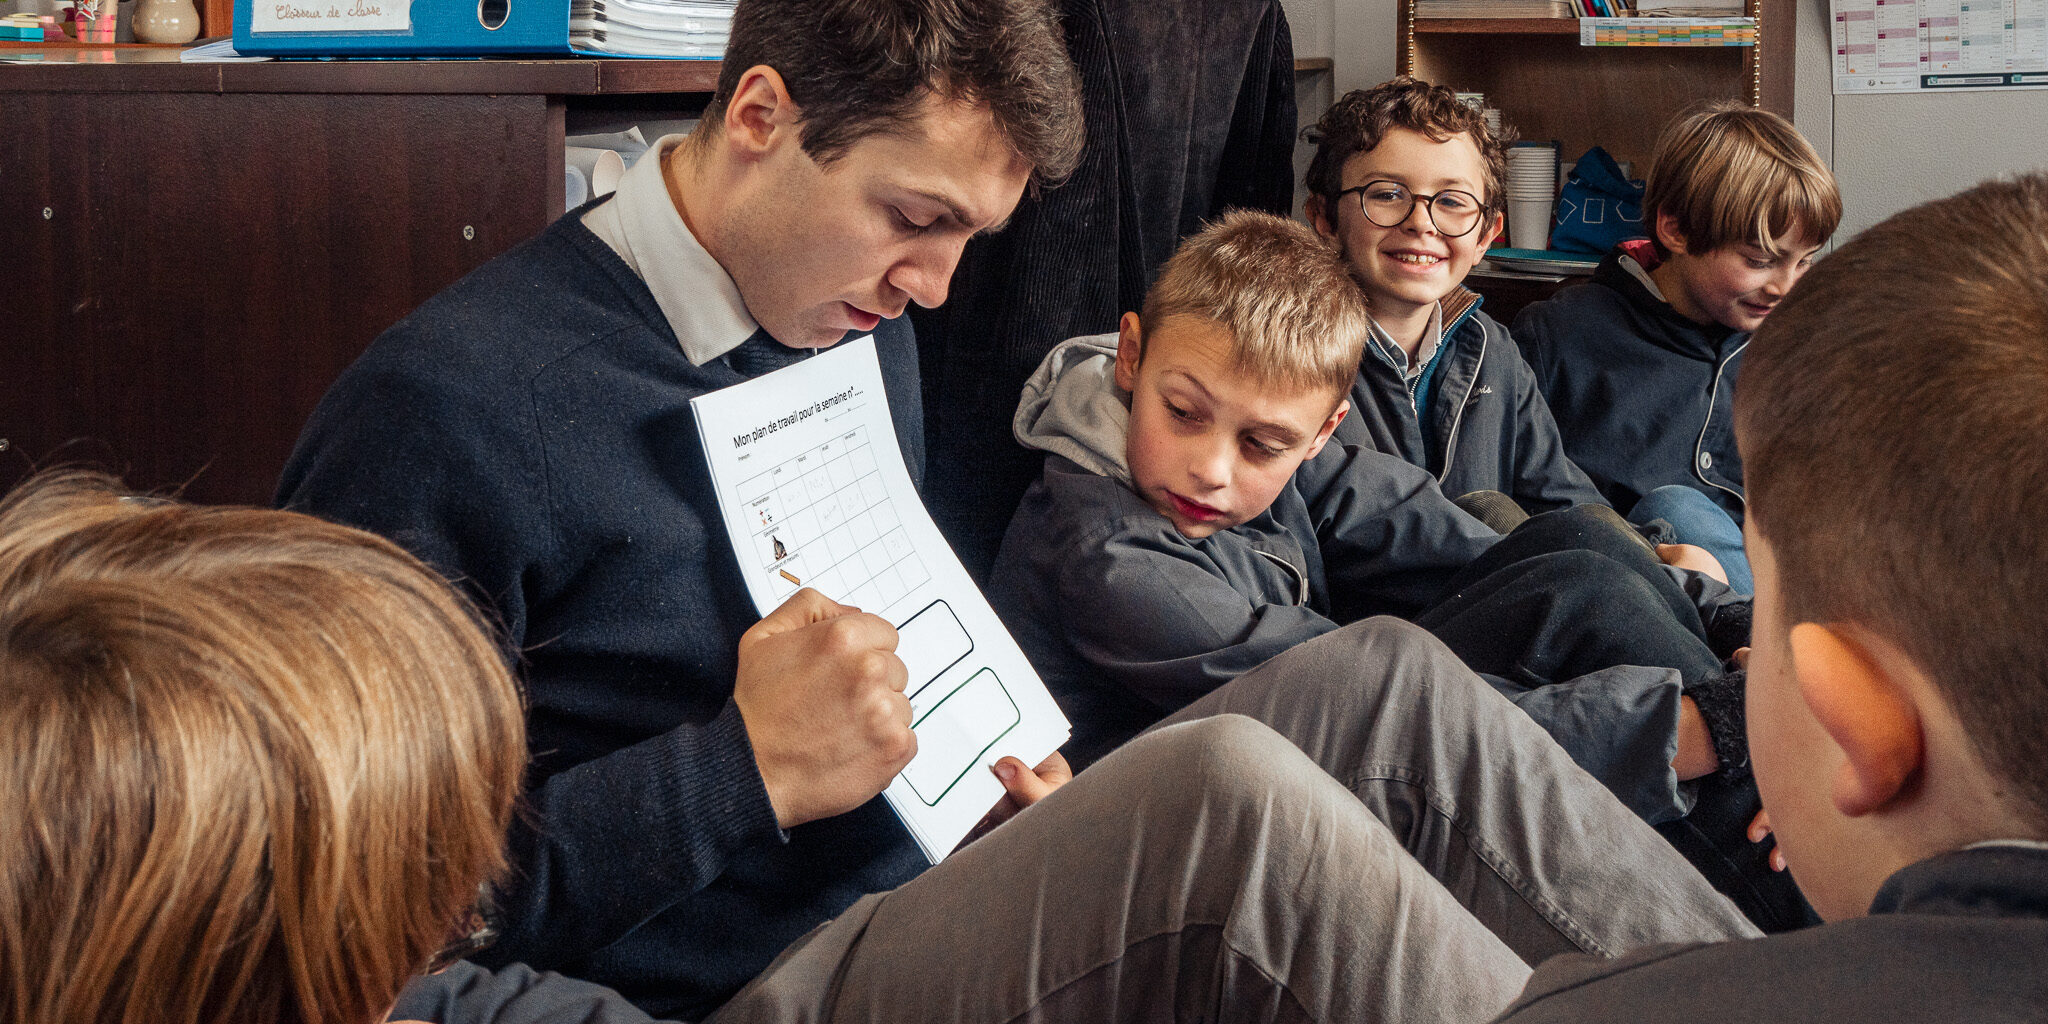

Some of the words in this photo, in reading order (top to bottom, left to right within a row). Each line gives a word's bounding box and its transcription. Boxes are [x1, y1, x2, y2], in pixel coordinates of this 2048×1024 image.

[326, 5, 341, 18] de
[733, 434, 751, 448] Mon
[752, 426, 767, 443] plan
[768, 420, 778, 434] de
[777, 410, 798, 428] travail
[799, 405, 814, 423] pour
[814, 401, 822, 413] la
[821, 393, 847, 410] semaine
